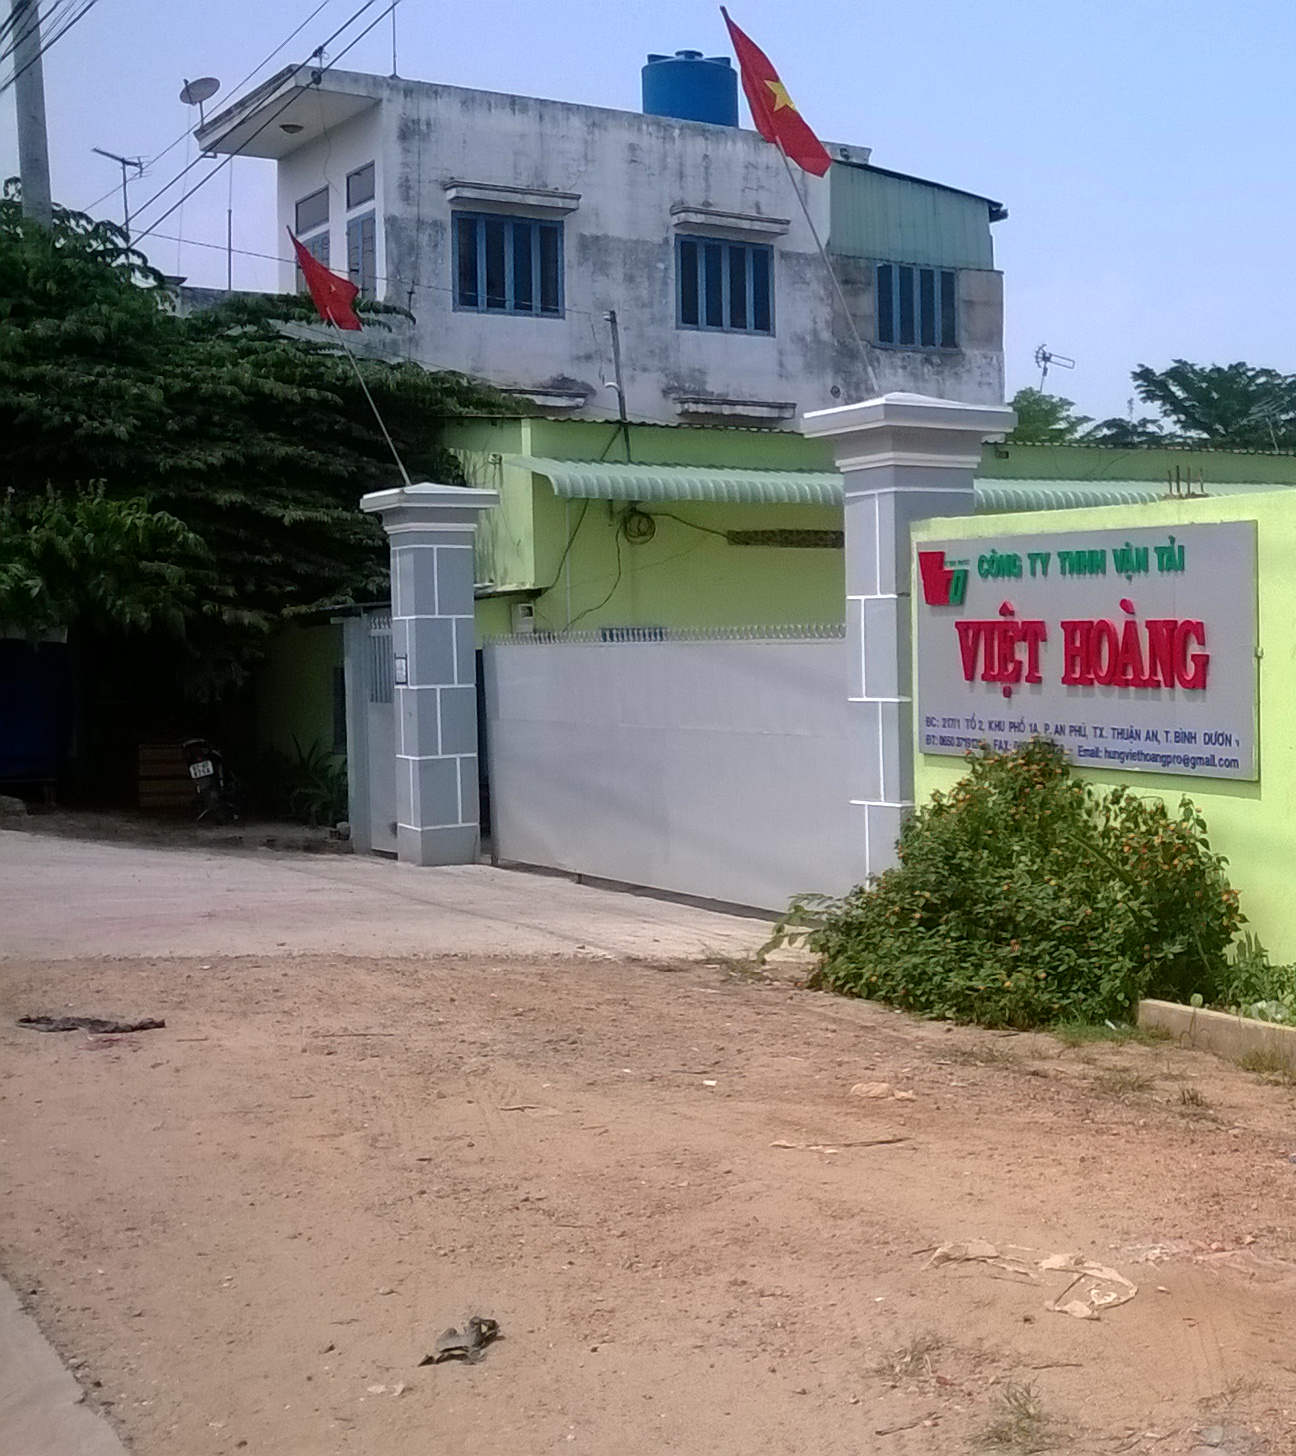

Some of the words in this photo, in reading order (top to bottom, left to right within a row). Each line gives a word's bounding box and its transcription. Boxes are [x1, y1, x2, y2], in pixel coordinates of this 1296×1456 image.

[1027, 552, 1050, 577] TY
[1057, 549, 1106, 576] TNHH
[1154, 535, 1186, 572] TẢI
[955, 600, 1047, 698] VIỆT
[1060, 598, 1210, 690] HOÀNG
[1111, 725, 1141, 744] THUẬN
[1203, 730, 1240, 748] DƯƠN
